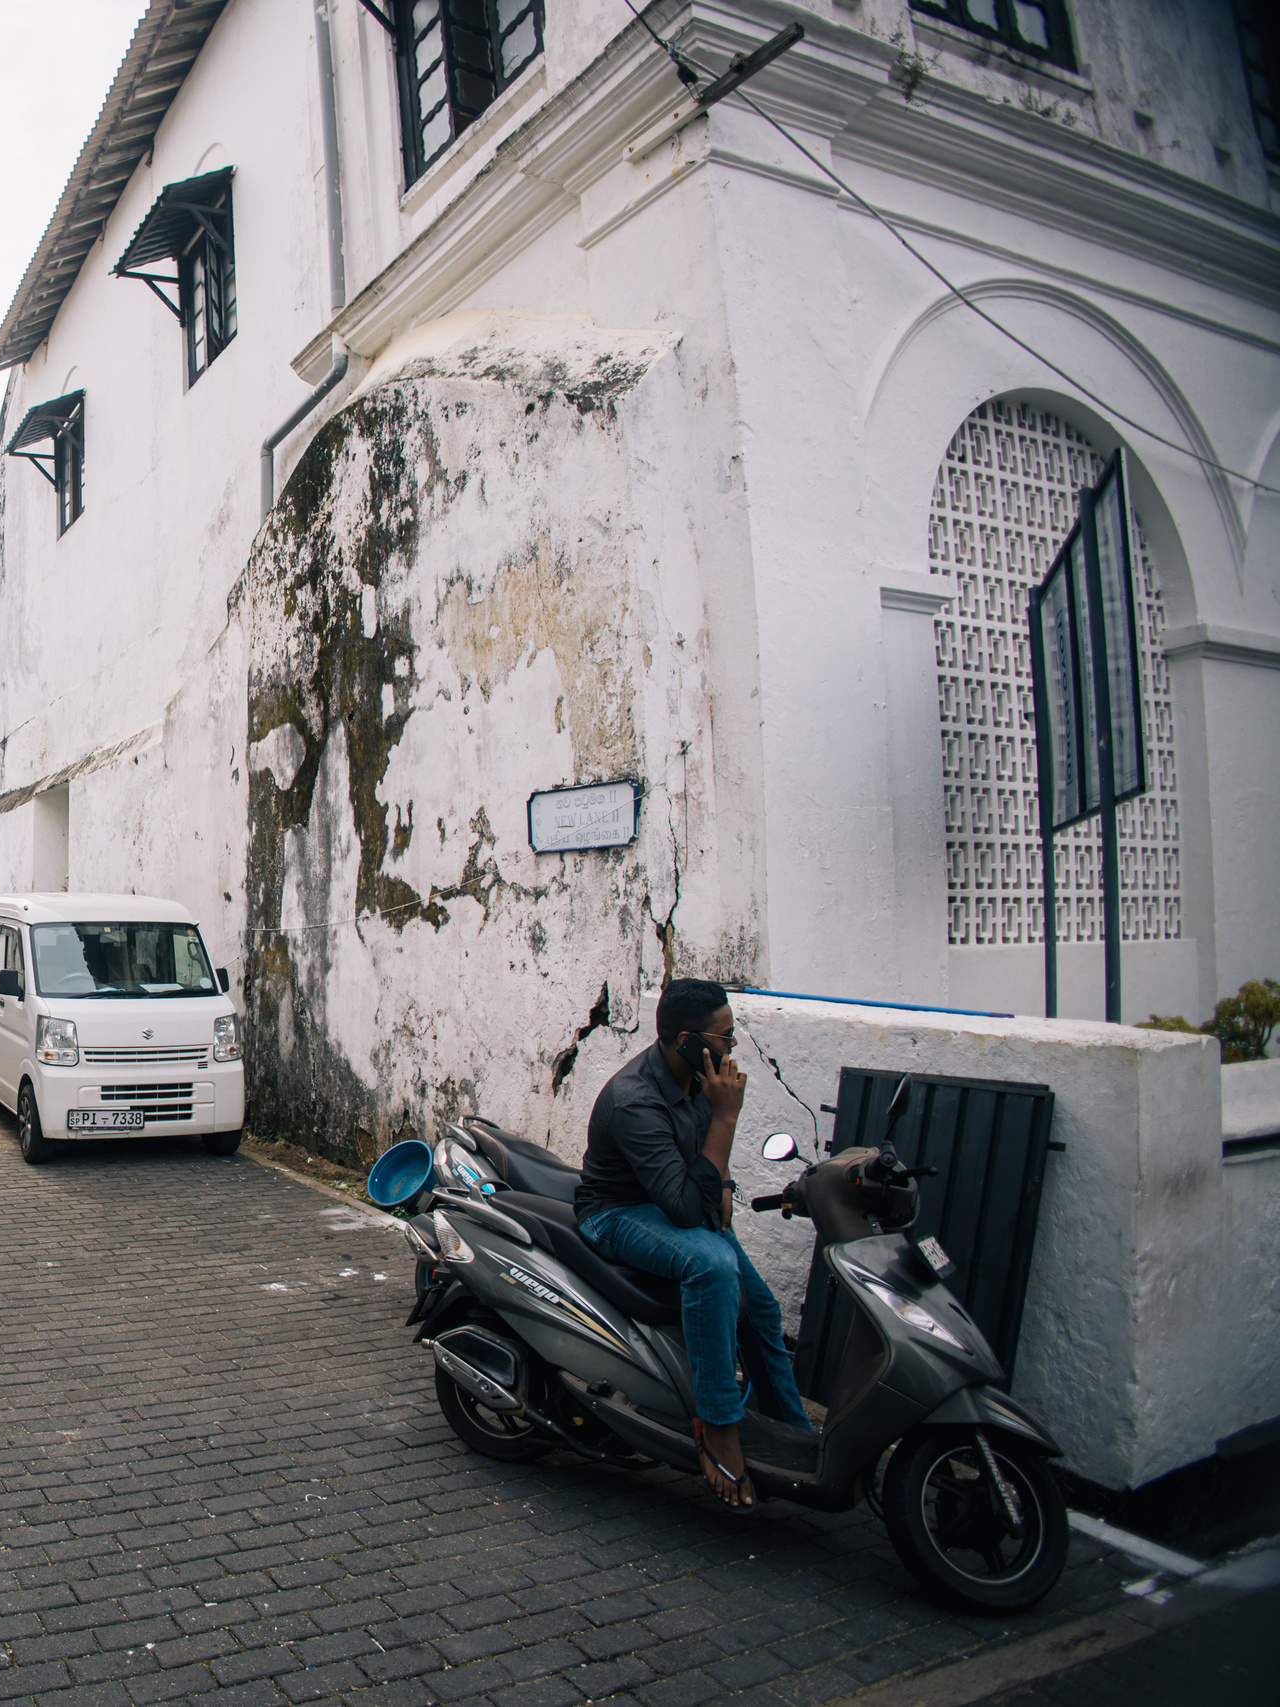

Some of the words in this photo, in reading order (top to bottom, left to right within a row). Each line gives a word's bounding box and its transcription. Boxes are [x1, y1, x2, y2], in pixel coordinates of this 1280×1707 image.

[555, 812, 577, 828] NEW
[579, 810, 609, 825] LANE
[456, 1164, 476, 1185] weg
[509, 1267, 560, 1304] wego
